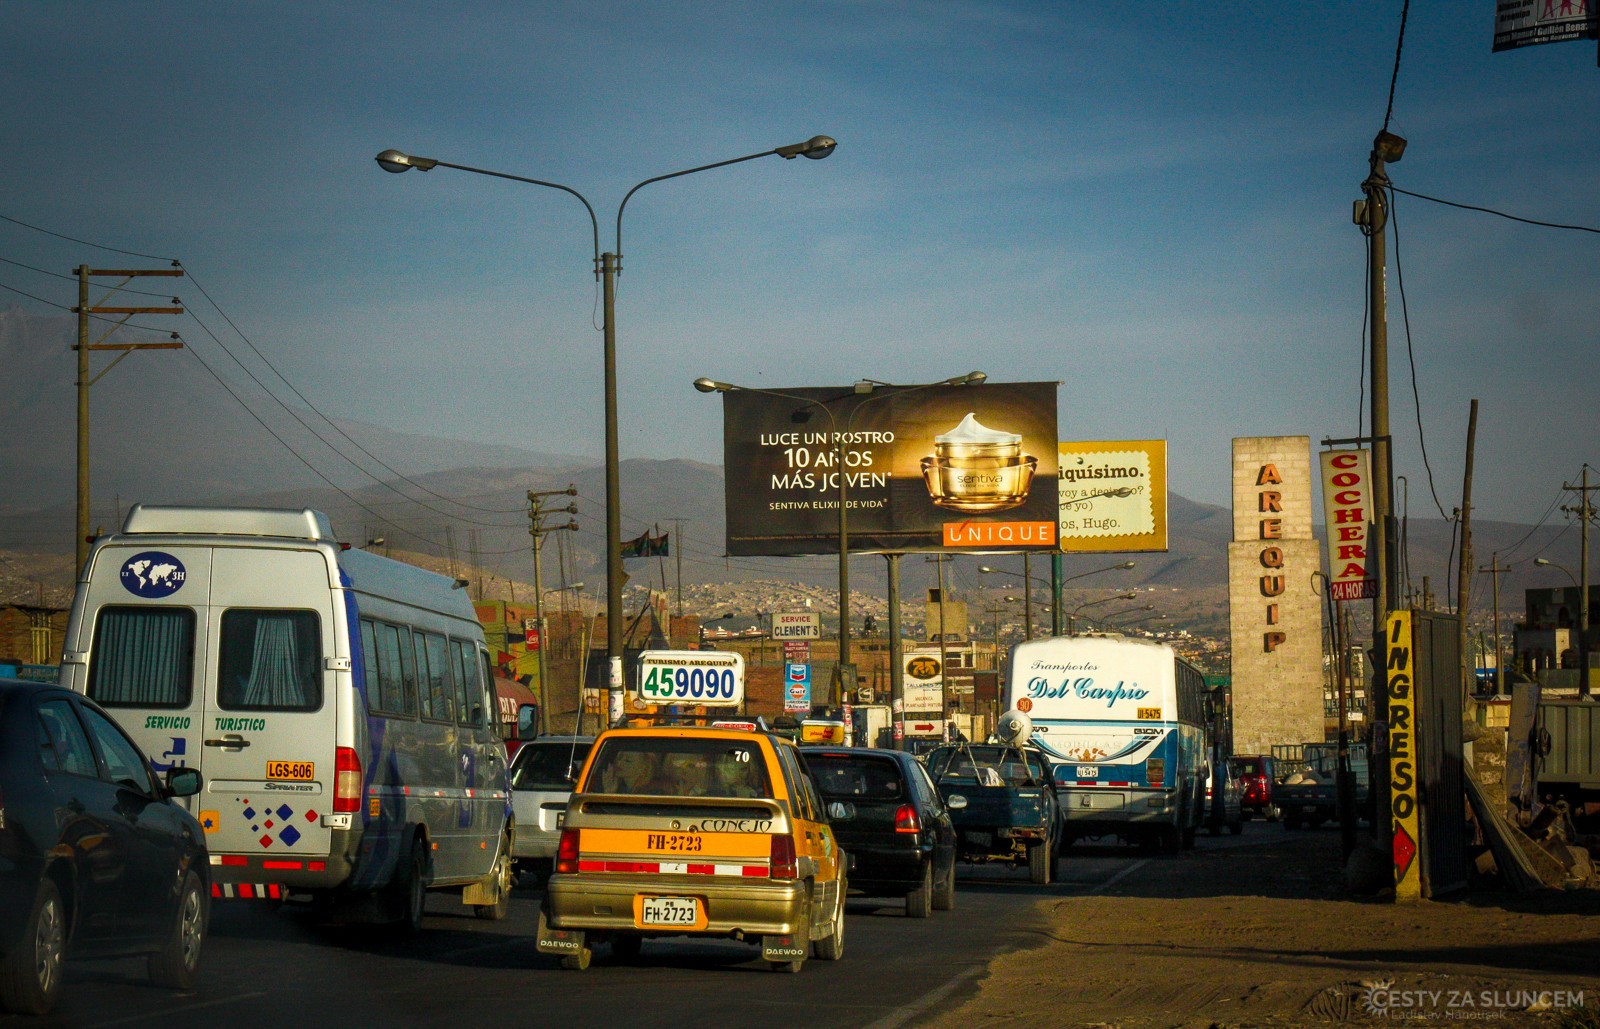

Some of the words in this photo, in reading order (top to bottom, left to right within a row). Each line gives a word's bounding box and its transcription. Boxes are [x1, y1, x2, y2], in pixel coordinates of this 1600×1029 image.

[761, 433, 799, 446] LUCE
[804, 432, 827, 444] UN
[832, 431, 895, 444] ROSTRO
[784, 447, 810, 468] 10
[814, 448, 873, 467] AÑOS
[771, 469, 815, 490] MÁS
[957, 474, 1003, 484] sentiva
[1059, 464, 1144, 483] iquísimo.
[1059, 490, 1077, 499] voy
[769, 501, 810, 511] SENTIVA
[813, 500, 844, 509] ELIXI
[846, 500, 858, 509] DE
[1074, 500, 1093, 512] yo)
[1330, 454, 1370, 578] COCHERA
[1083, 518, 1120, 530] Hugo.
[950, 523, 1048, 542] UNIQUE
[172, 571, 185, 581] 3H
[1333, 583, 1344, 600] 24
[1345, 581, 1376, 599] HORAS
[781, 615, 811, 623] SERVICE
[647, 658, 687, 666] TURISMO
[689, 659, 733, 667] AREQUIPA
[1030, 659, 1099, 674] Transportes
[644, 667, 735, 699] 459090
[1026, 676, 1070, 699] Del
[1073, 677, 1150, 708] Carpio
[1020, 700, 1029, 710] 90
[1137, 708, 1161, 719] UI-5475
[1388, 618, 1414, 819] INGRESO
[145, 715, 191, 730] SERVICIO
[215, 717, 266, 731] TURISTICO
[734, 750, 750, 763] 70
[269, 763, 312, 778] LGS-606
[700, 819, 773, 833] CONEJO
[647, 834, 702, 852] FH-2723
[645, 906, 694, 921] FH-2723
[540, 940, 579, 949] DAEWOO
[766, 948, 804, 956] DAEWOO
